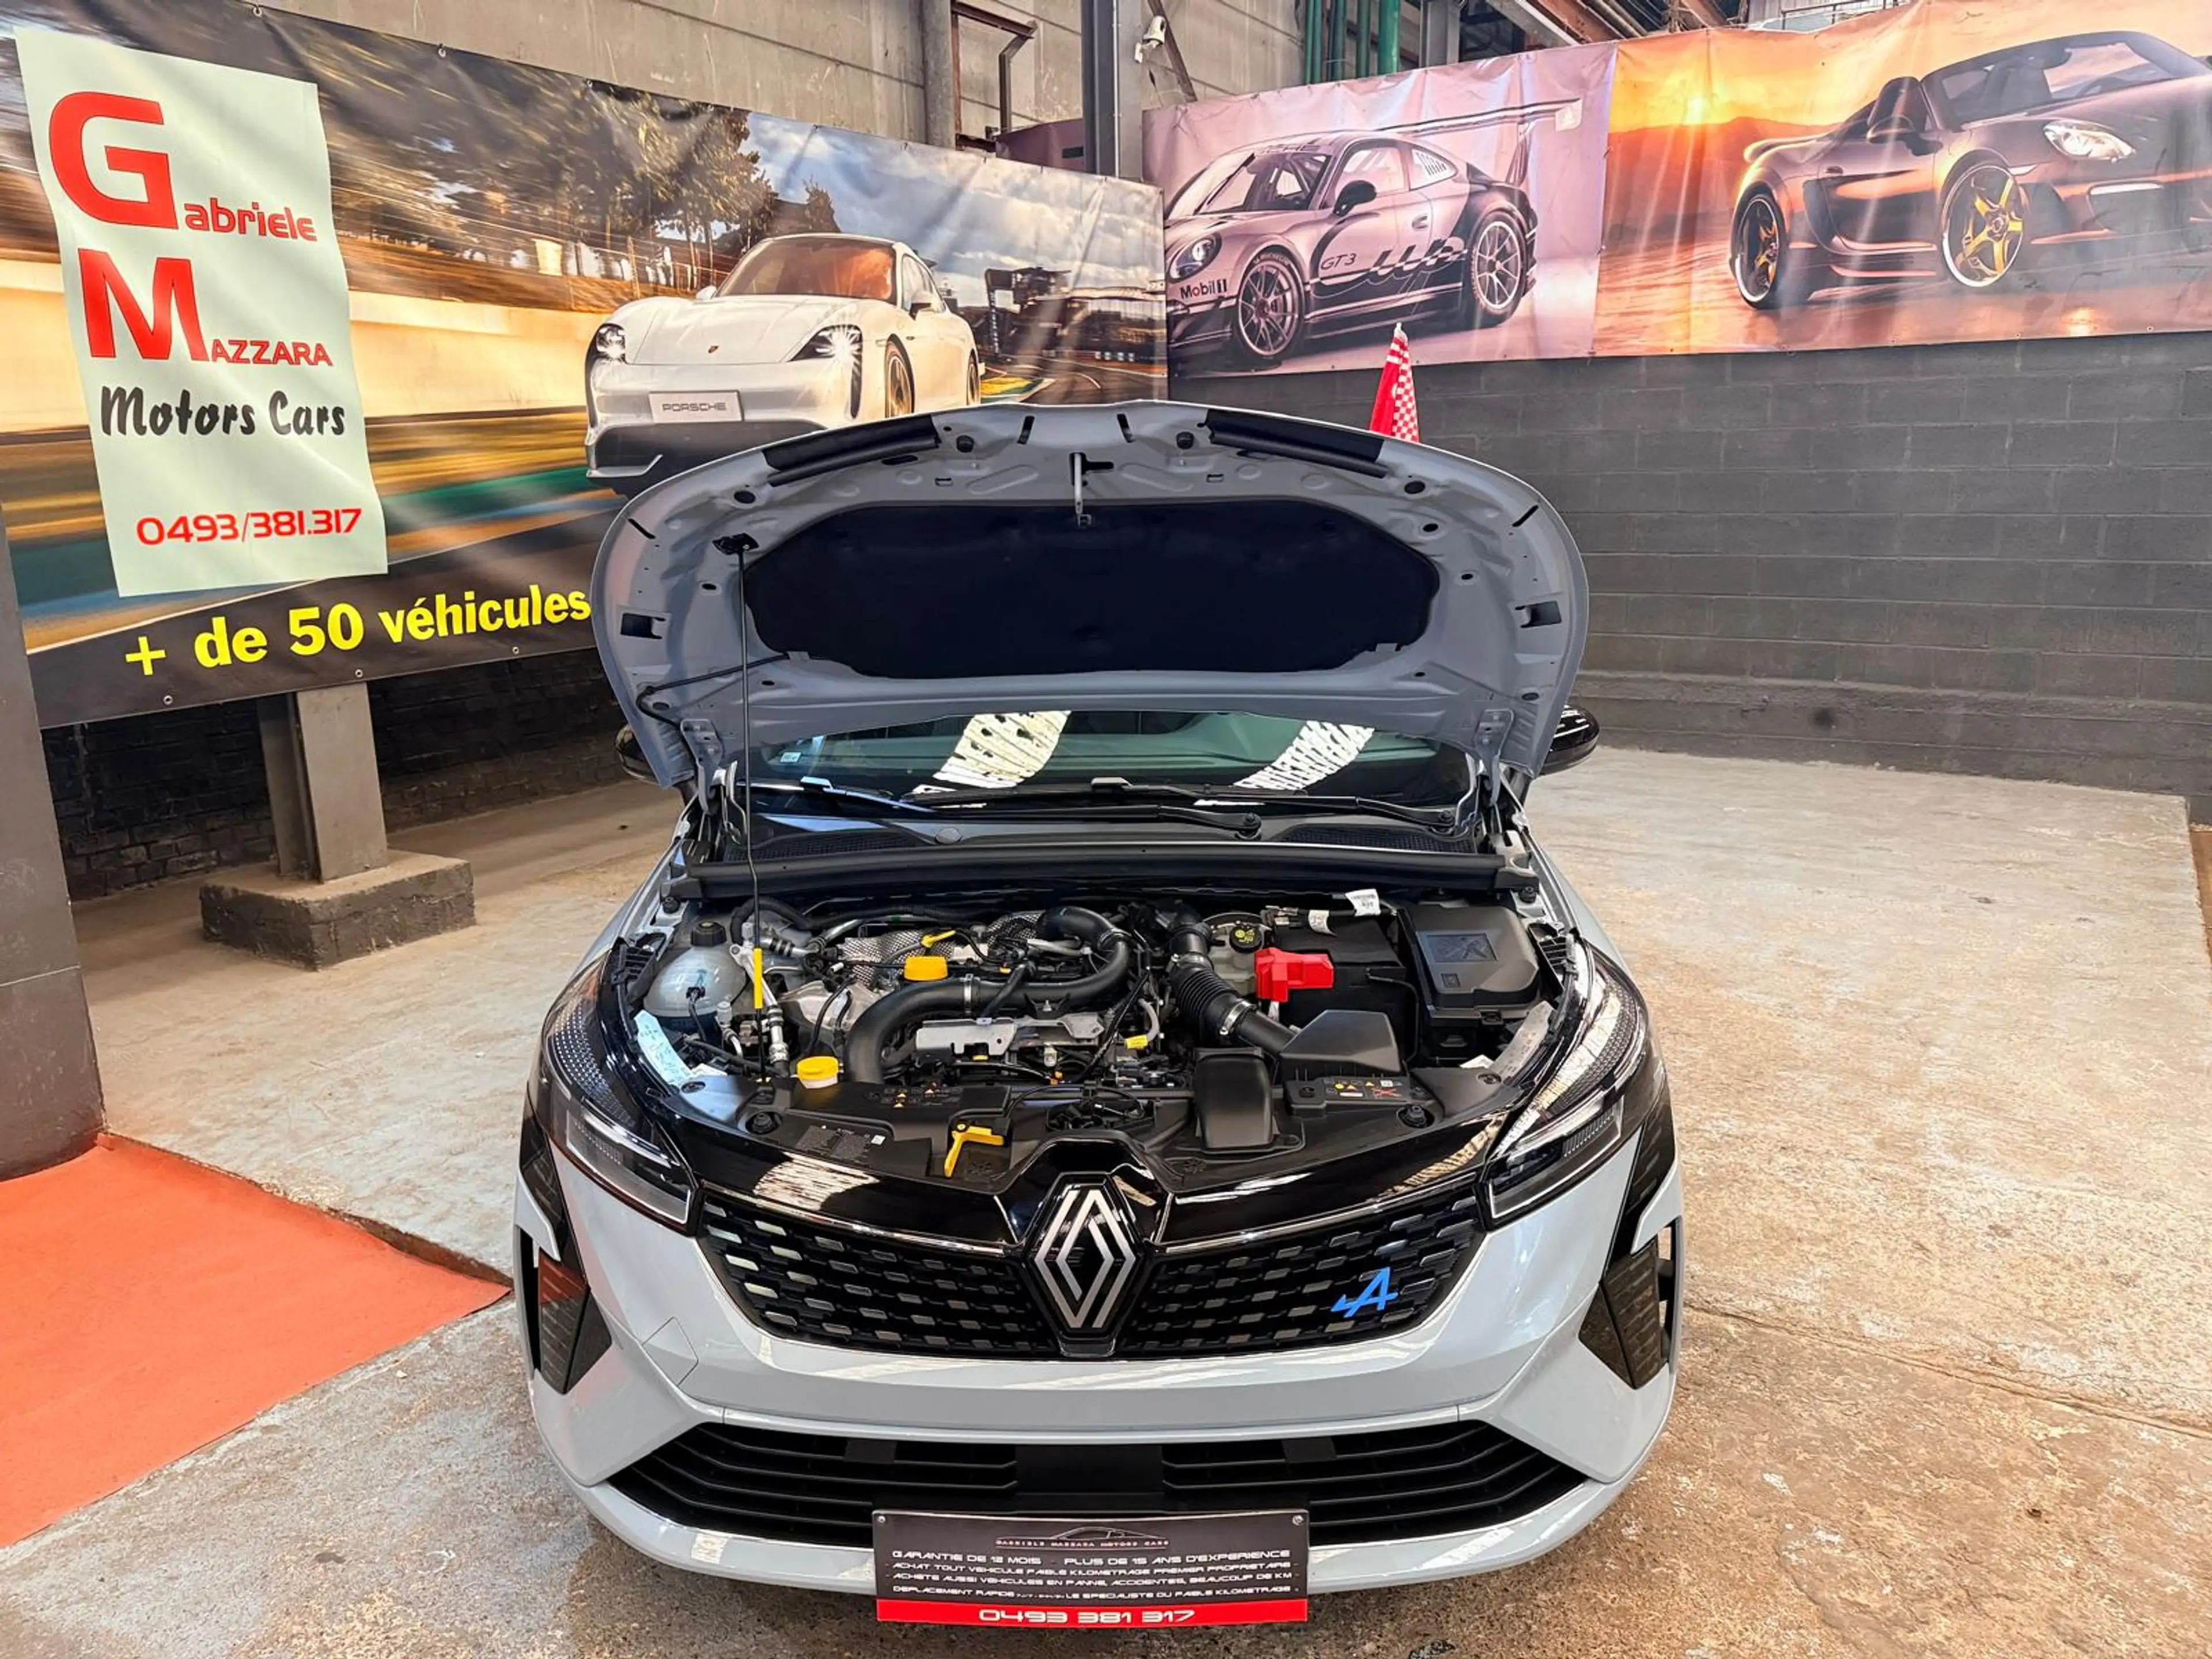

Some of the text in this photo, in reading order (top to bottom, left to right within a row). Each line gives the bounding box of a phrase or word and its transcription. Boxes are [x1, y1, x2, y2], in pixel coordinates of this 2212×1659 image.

[49, 91, 317, 241] Gabriele
[1320, 253, 1357, 270] GT3
[1180, 280, 1215, 299] Mobil
[100, 386, 345, 435] Motors Cars
[662, 403, 727, 412] PORSCHE
[136, 507, 362, 546] 0493/381.317
[194, 617, 267, 668] de
[289, 603, 365, 656] 50
[378, 585, 591, 643] véhicules
[892, 1551, 963, 1562] GARANTIE
[967, 1555, 987, 1563] DE
[1007, 1556, 1041, 1565] MOIS
[1152, 1556, 1181, 1565] ANS
[968, 1566, 1024, 1574] VEHICULE
[1153, 1566, 1204, 1574] PREMIER
[893, 1573, 940, 1581] ACHETE
[980, 1577, 1044, 1585] VEHICULES
[1189, 1574, 1254, 1584] BEAUCOUP
[893, 1585, 973, 1595] DEPLACEMENT
[976, 1589, 1015, 1597] RAPIDE
[979, 1609, 1195, 1623] 0493 381 317
